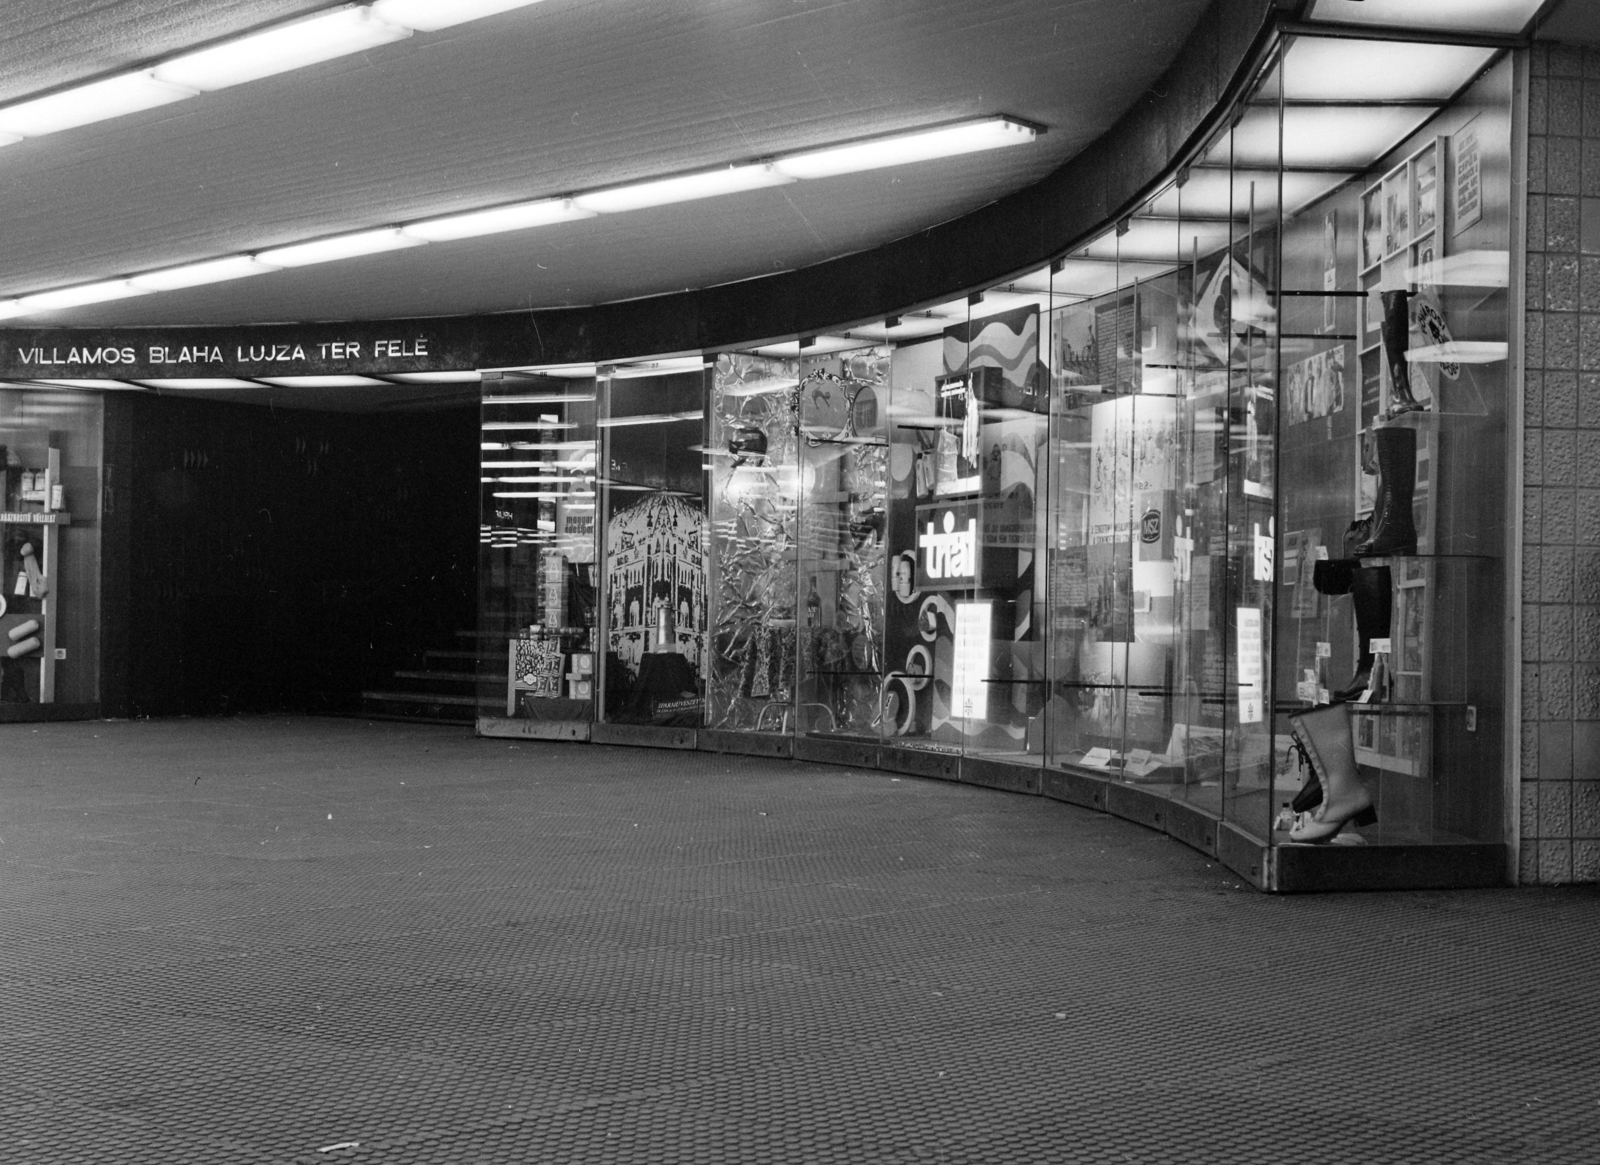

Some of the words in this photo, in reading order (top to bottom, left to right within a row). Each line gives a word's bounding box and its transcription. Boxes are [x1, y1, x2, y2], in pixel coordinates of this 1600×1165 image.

[18, 346, 136, 365] VILLAMOS
[149, 345, 224, 364] BLAHA
[237, 343, 306, 362] LUJZA
[317, 337, 362, 359] TÉR
[374, 333, 429, 357] FELÉ
[566, 516, 593, 526] magyar
[1143, 518, 1159, 535] MSZ
[564, 524, 594, 536] édesipar
[919, 510, 976, 578] trial
